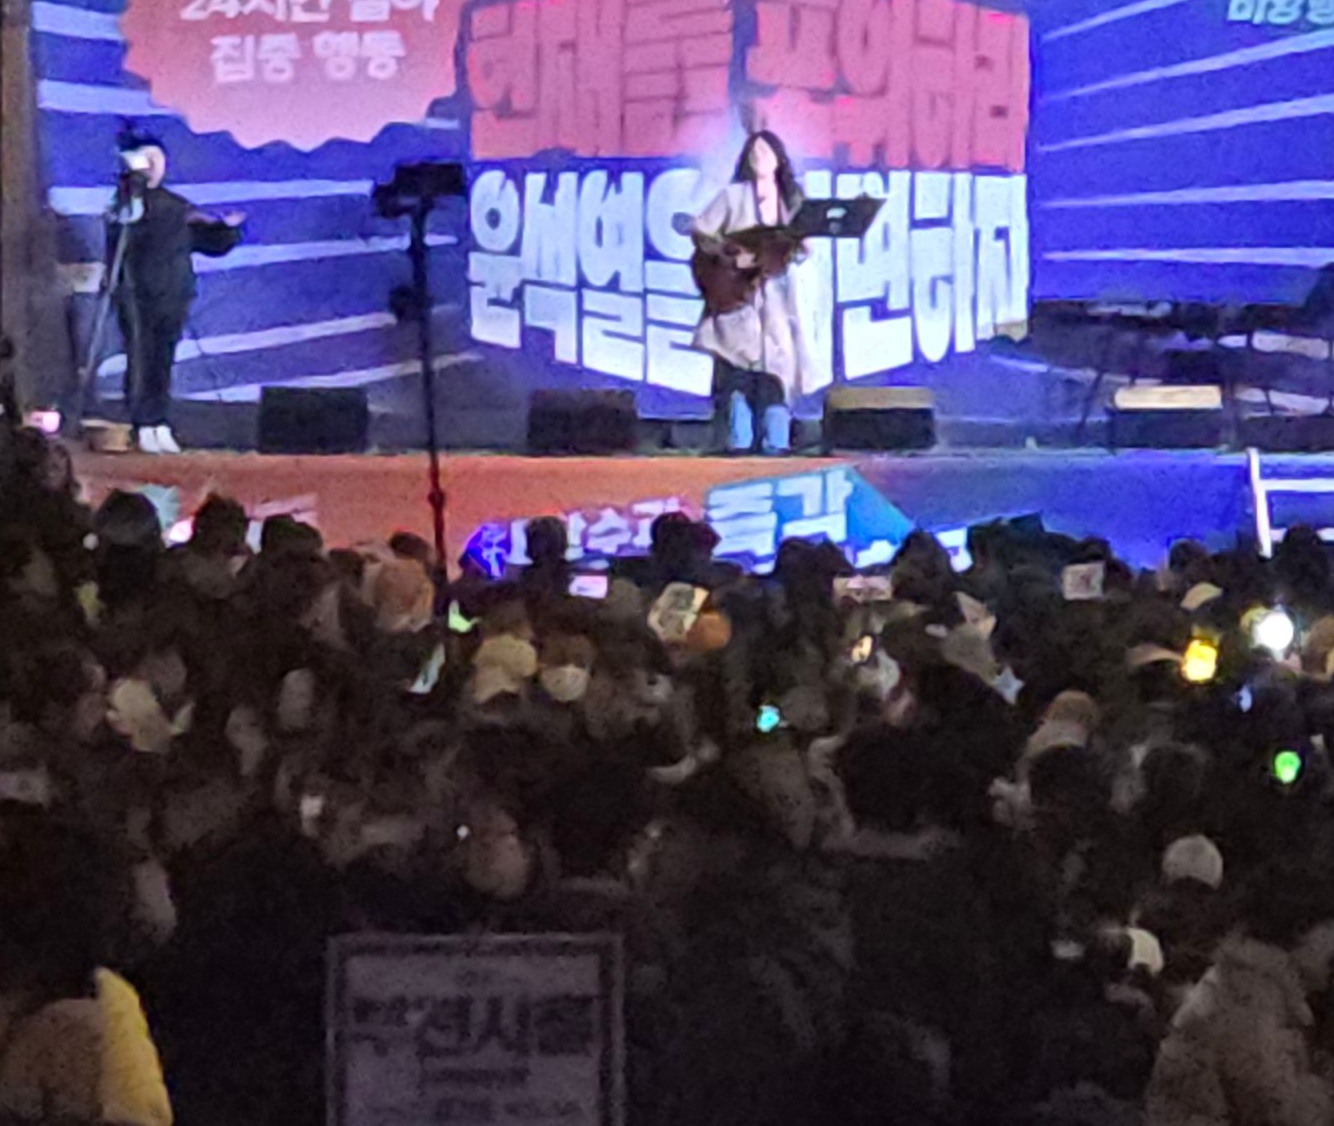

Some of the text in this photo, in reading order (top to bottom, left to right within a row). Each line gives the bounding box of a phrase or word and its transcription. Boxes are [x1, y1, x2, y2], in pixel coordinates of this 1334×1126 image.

[209, 29, 406, 84] 집중 행동
[467, 168, 1028, 397] 윤석열을 면하자
